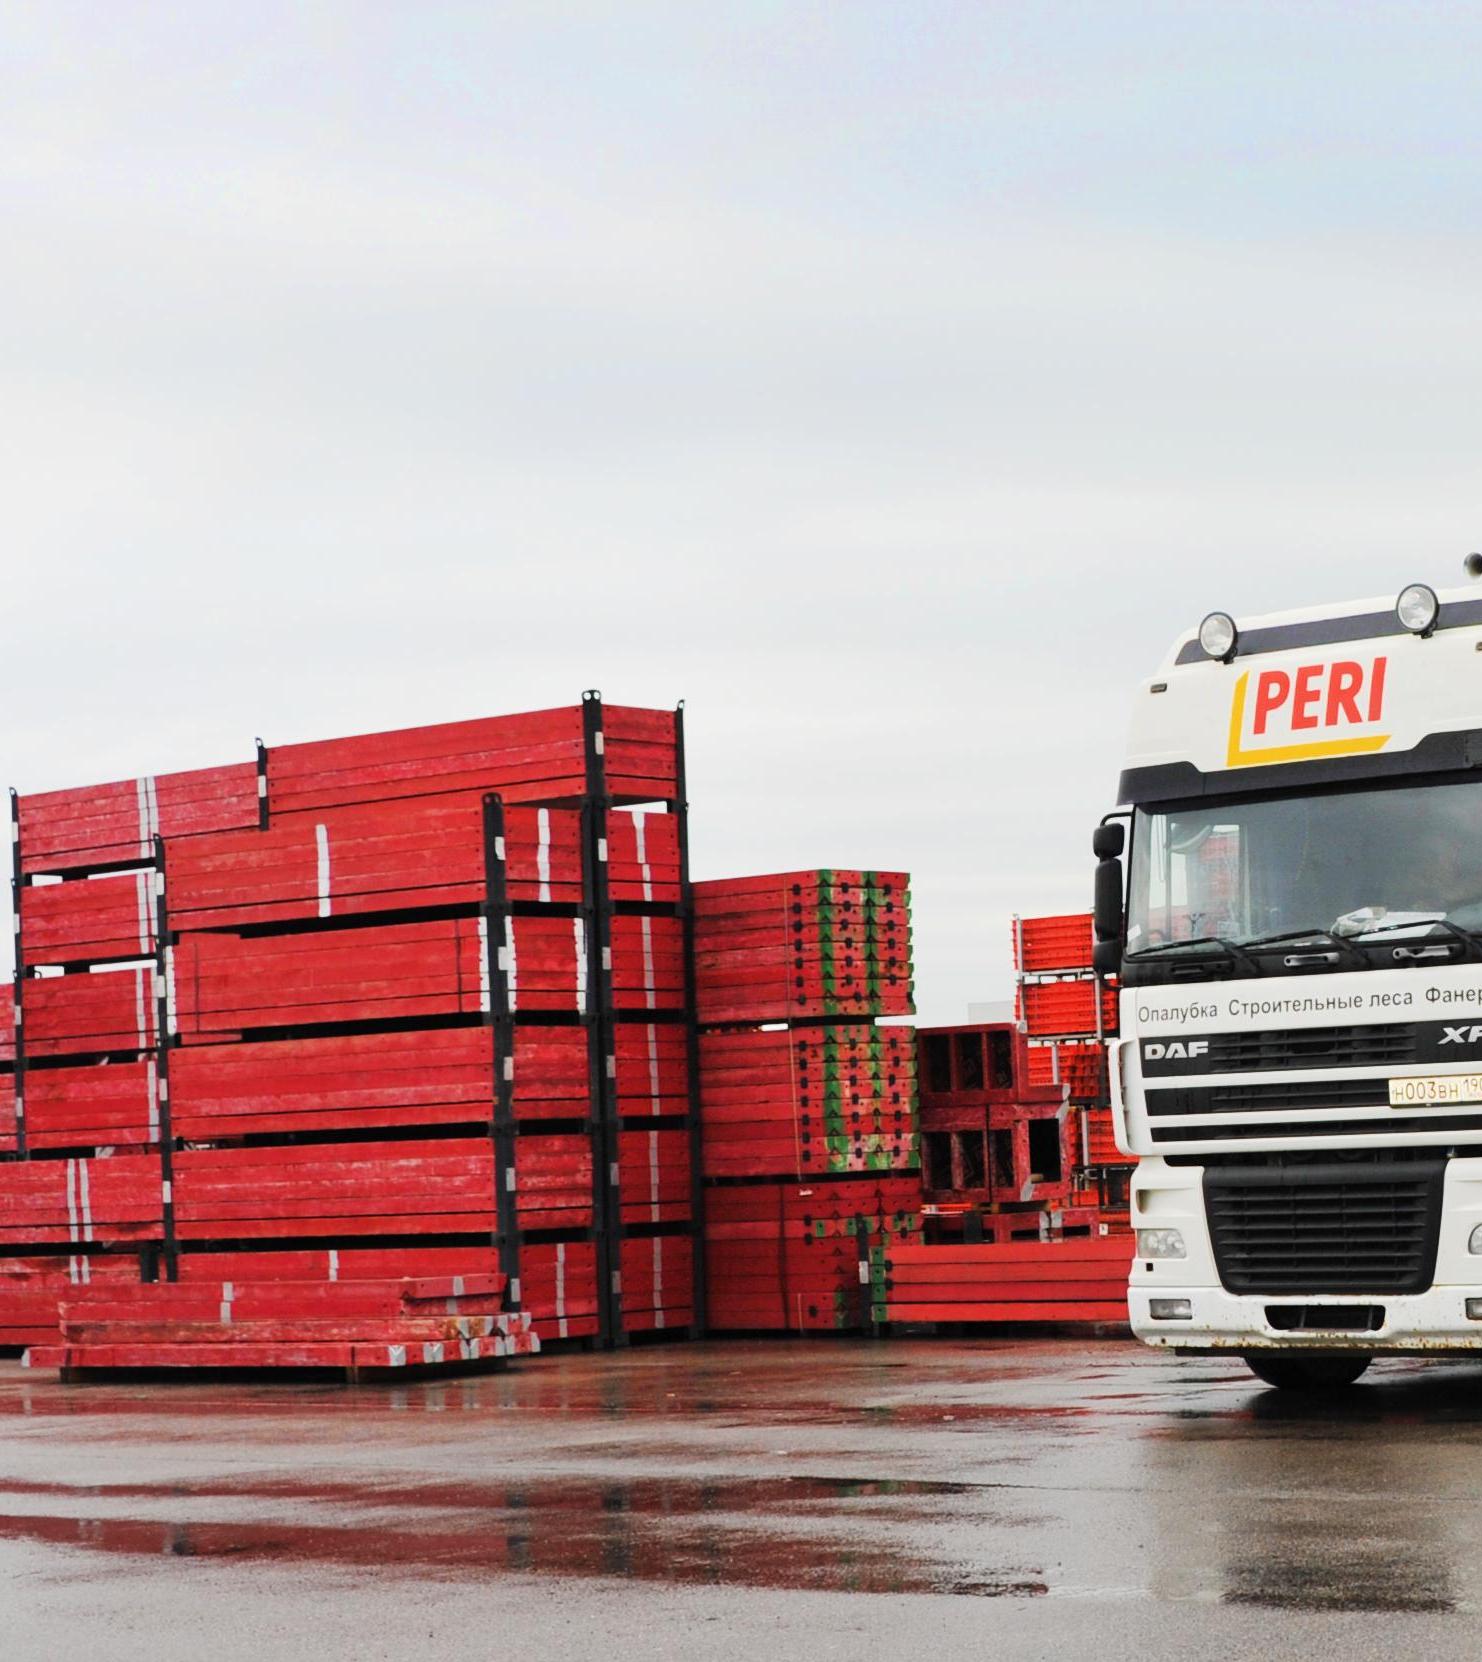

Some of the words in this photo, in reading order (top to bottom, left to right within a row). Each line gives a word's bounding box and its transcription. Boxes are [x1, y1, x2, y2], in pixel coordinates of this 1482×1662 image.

[1253, 656, 1387, 735] PERI
[1138, 1002, 1218, 1024] Опалубка
[1229, 995, 1363, 1019] Строительные
[1369, 992, 1413, 1007] леса
[1144, 1041, 1209, 1060] DAF
